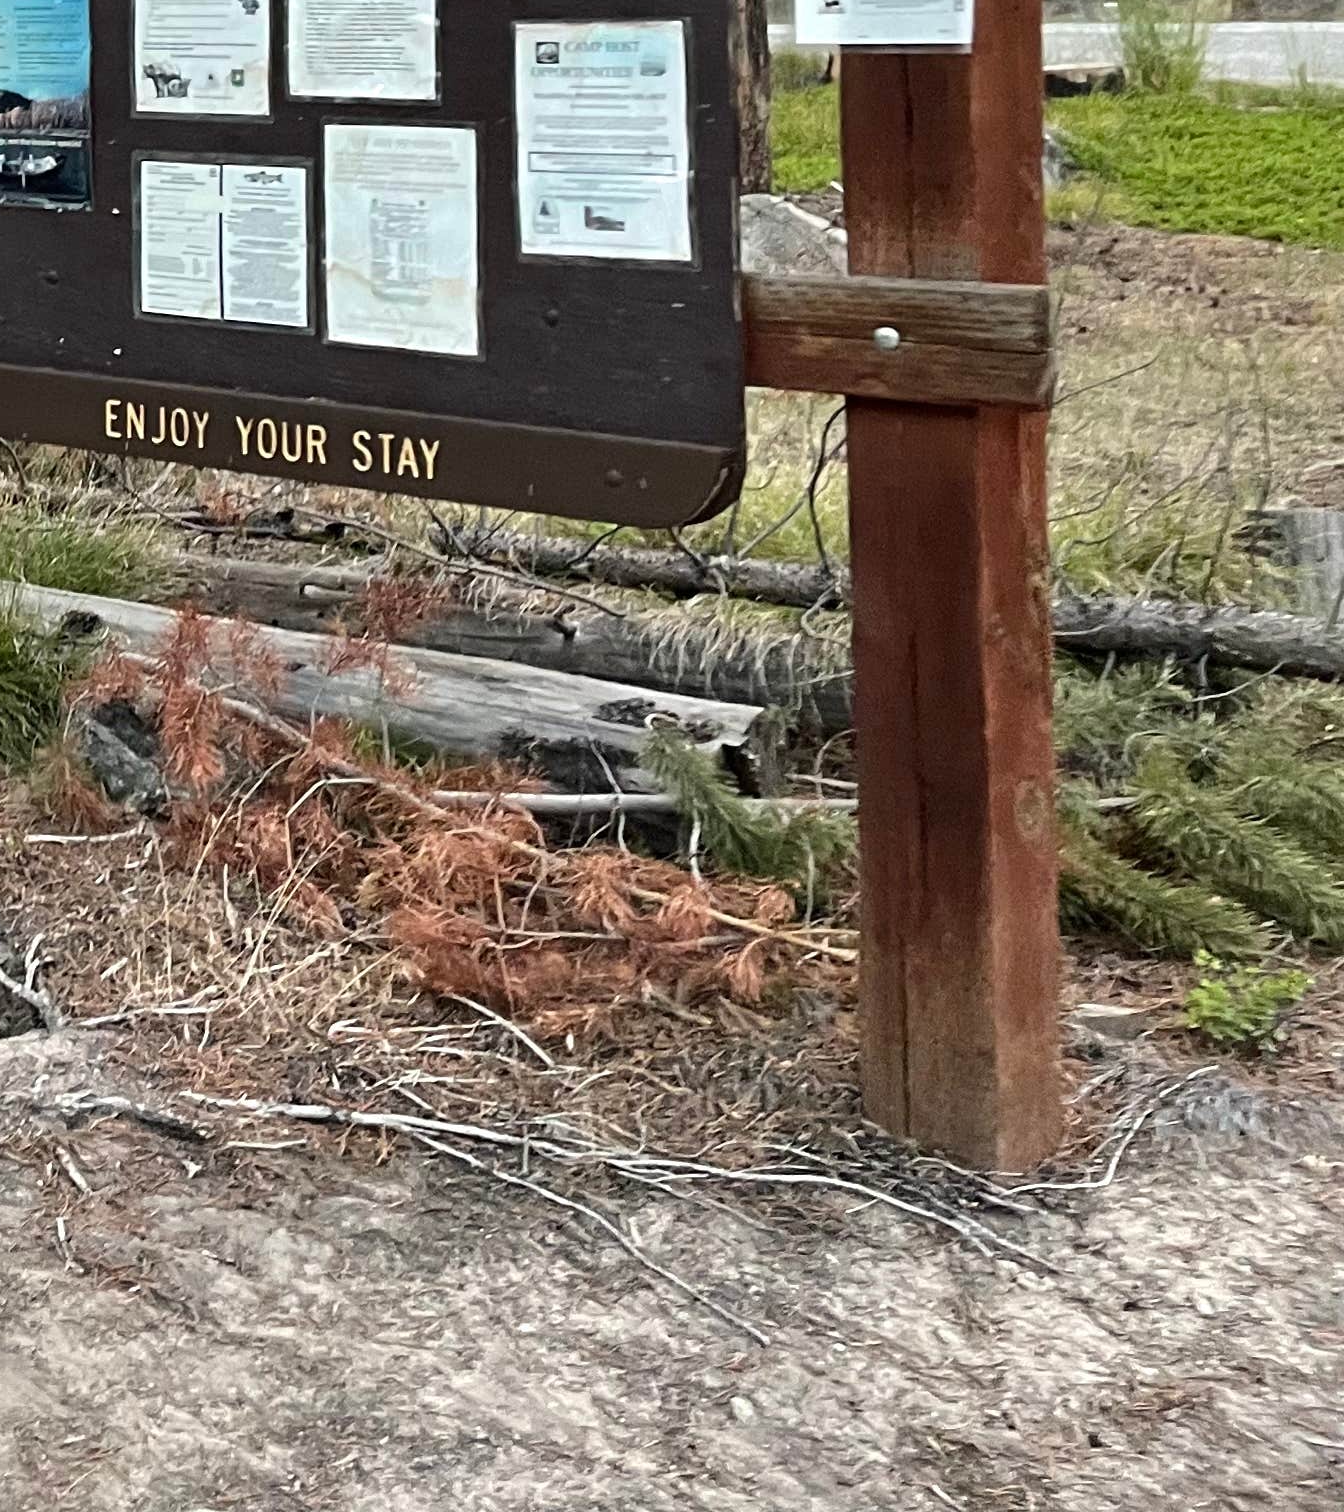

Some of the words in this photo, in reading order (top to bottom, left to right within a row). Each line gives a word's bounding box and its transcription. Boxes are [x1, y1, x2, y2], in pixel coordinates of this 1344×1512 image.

[105, 399, 210, 449] ENJOY
[236, 415, 327, 465] YOUR
[352, 430, 440, 480] STAY
